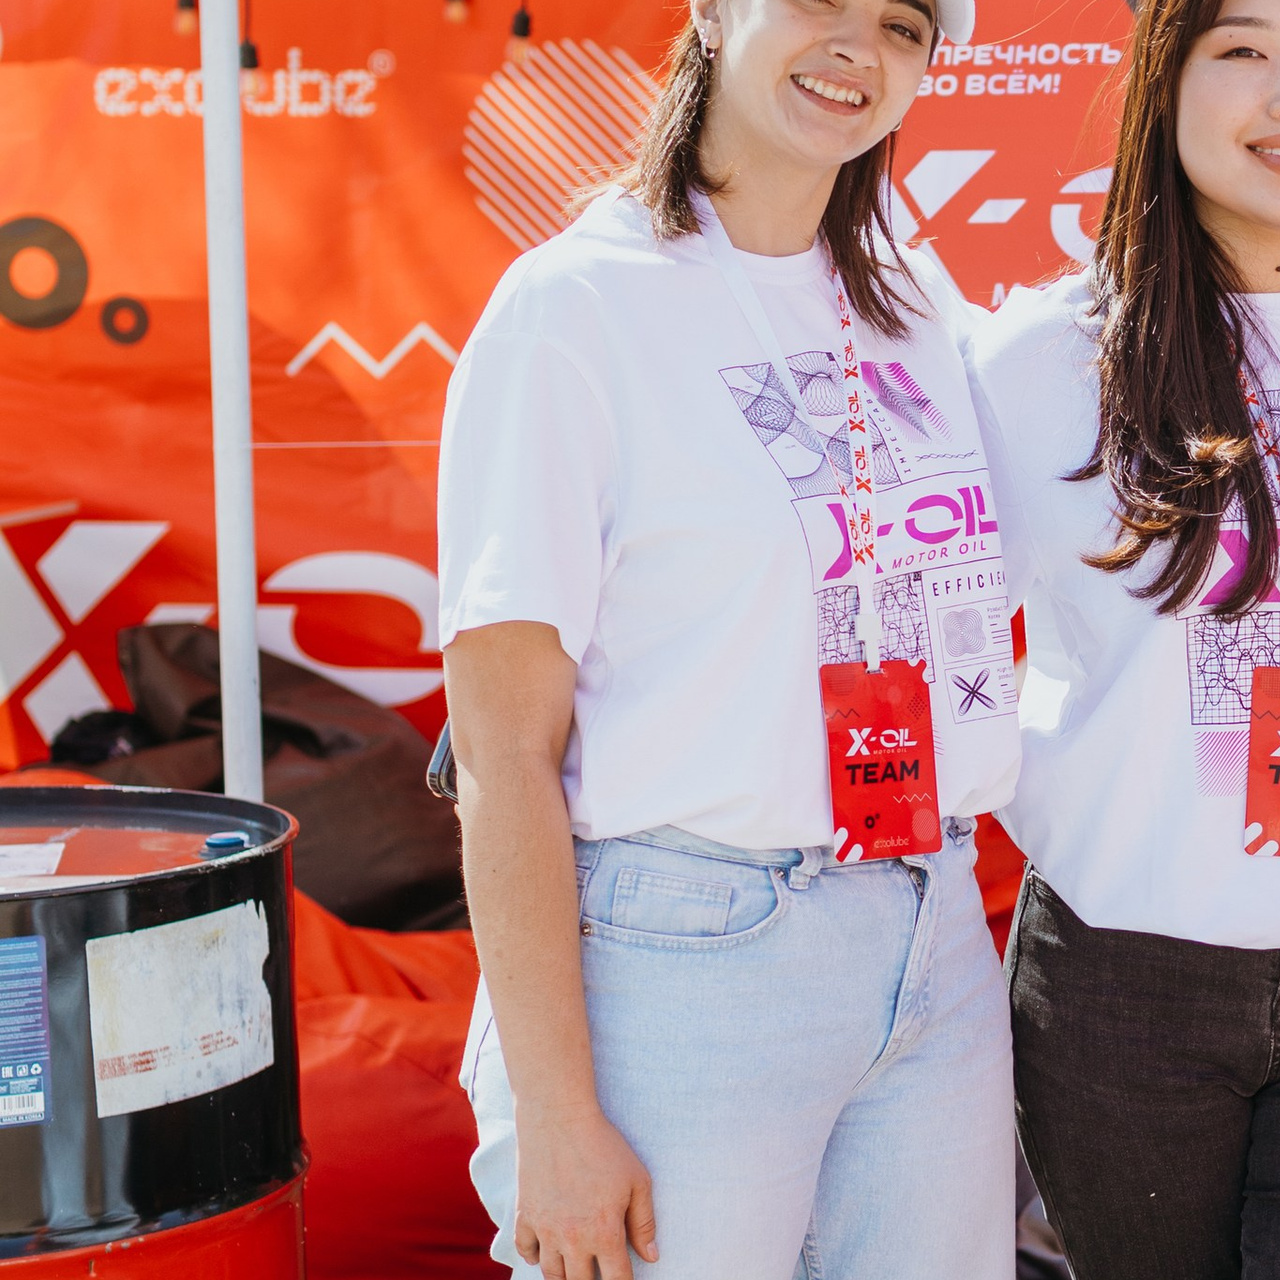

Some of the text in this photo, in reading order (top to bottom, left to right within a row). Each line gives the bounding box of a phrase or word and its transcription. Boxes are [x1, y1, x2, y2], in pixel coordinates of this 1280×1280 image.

[931, 42, 1123, 67] ПРЕЧНОСТЬ
[93, 46, 377, 117] exoube
[964, 69, 1062, 96] ВСЁМ!
[844, 339, 859, 380] X-OIL
[848, 390, 867, 434] X-OIL
[854, 445, 873, 495] X-OIL
[849, 514, 866, 566] X-OIL
[860, 507, 875, 561] X-OIL
[891, 539, 987, 570] MOTOR OIL
[845, 727, 918, 757] X-OIL
[845, 760, 919, 785] TEAM
[874, 835, 910, 849] exolube
